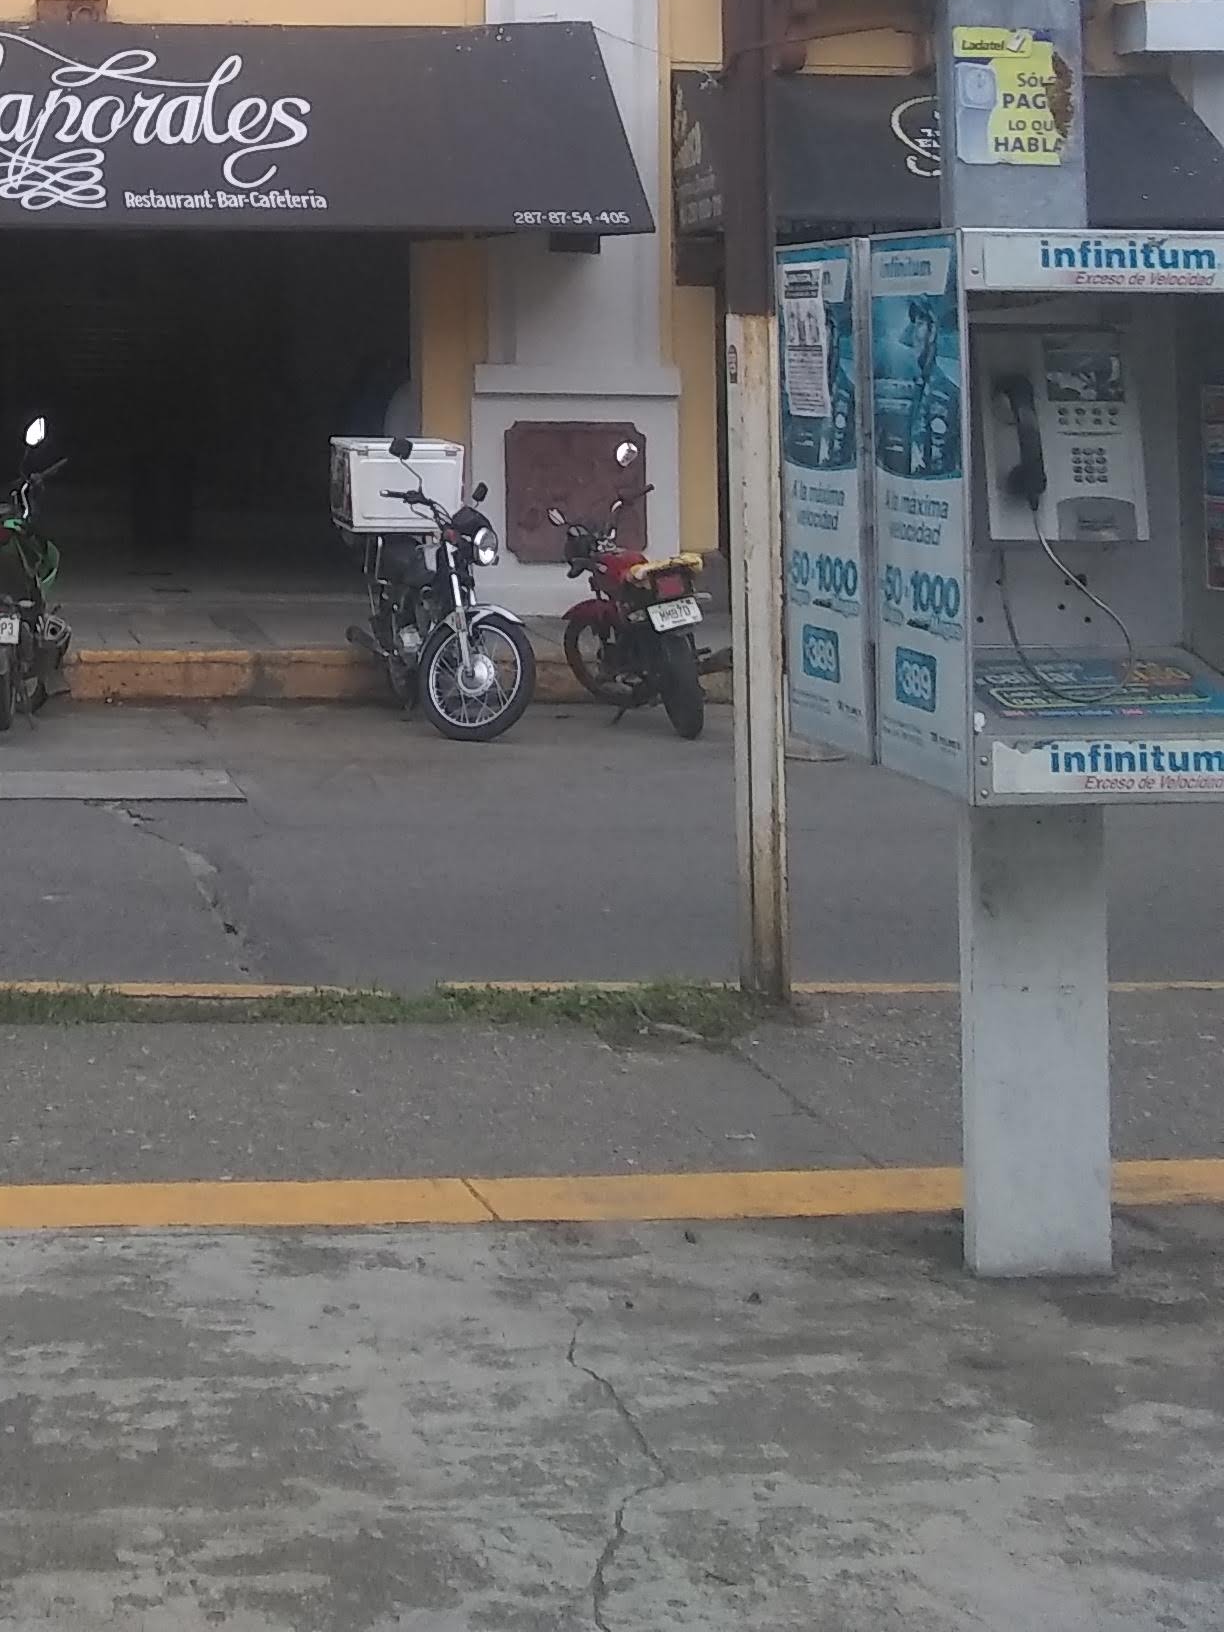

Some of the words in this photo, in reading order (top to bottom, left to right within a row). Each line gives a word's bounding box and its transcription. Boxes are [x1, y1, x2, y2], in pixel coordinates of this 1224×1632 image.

[961, 40, 1005, 50] Ladatel
[1008, 120, 1026, 131] LO
[1040, 239, 1217, 270] infinitum
[1075, 271, 1125, 285] Exceso
[1128, 272, 1146, 286] de
[1150, 272, 1216, 286] Velocidad
[1084, 775, 1135, 790] Exceso
[1138, 775, 1155, 790] de
